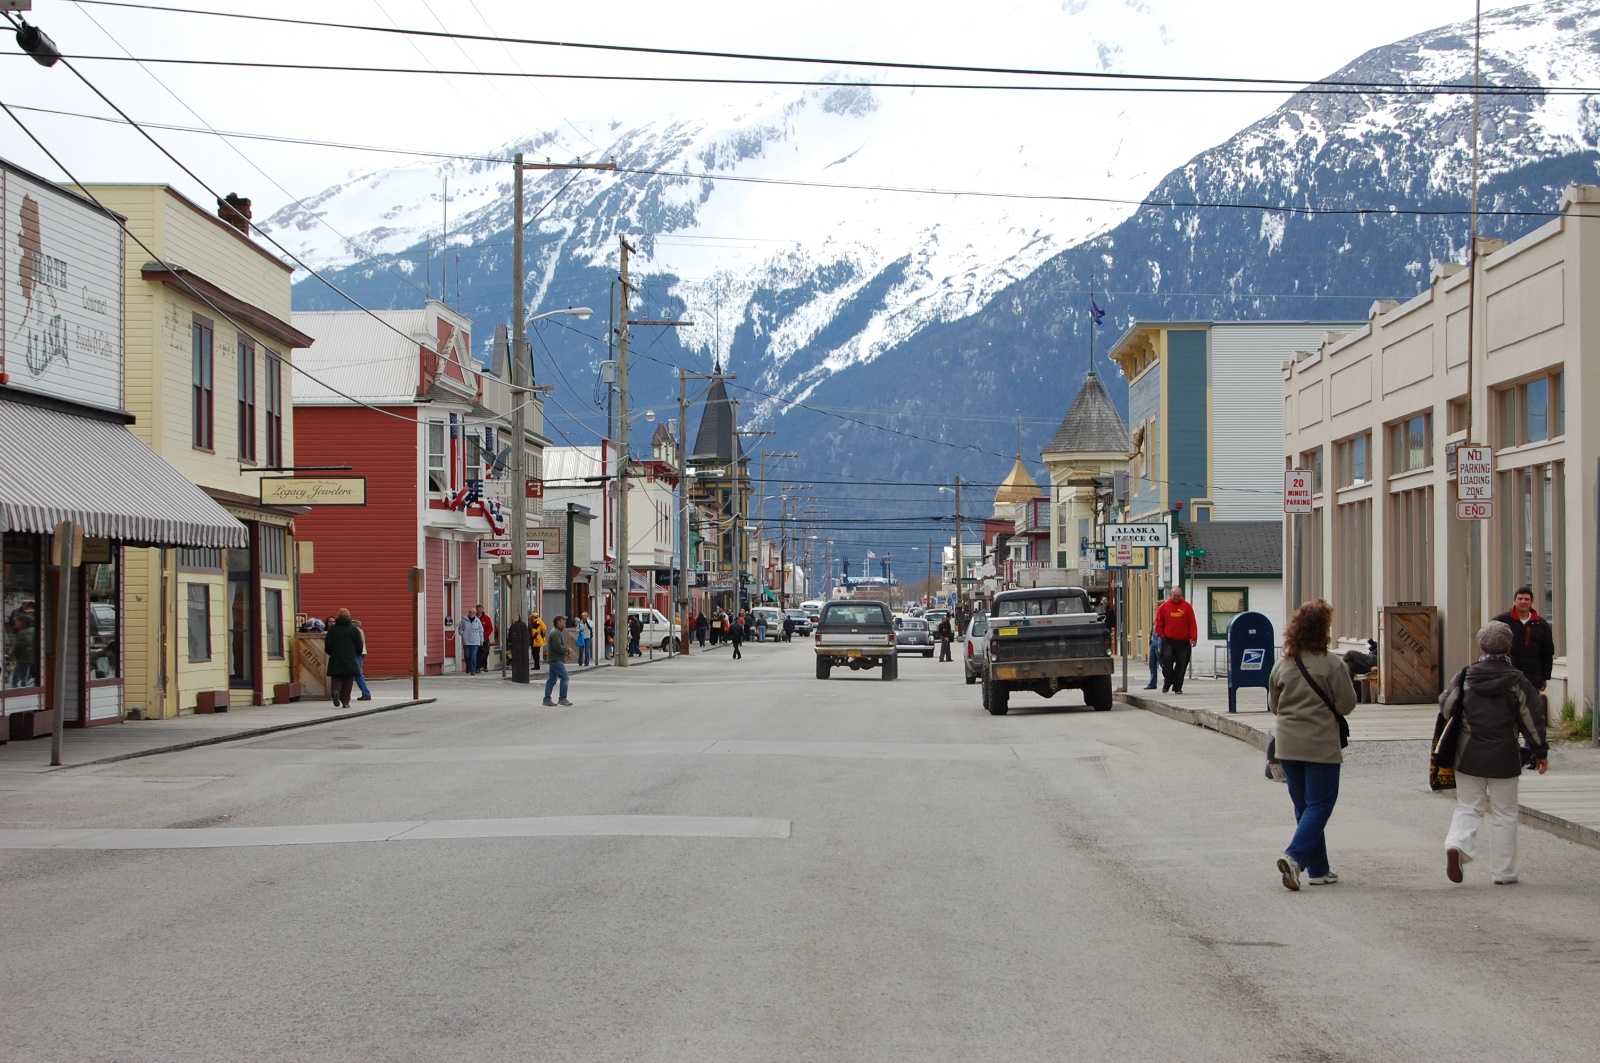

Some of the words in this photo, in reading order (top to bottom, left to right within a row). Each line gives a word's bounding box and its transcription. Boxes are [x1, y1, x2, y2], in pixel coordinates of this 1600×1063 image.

[32, 251, 68, 289] NORTH
[1467, 451, 1482, 461] NO
[1460, 463, 1490, 474] PARKING
[1293, 479, 1304, 488] 20
[1460, 476, 1490, 485] LOADING
[271, 485, 307, 499] Legacy
[306, 484, 353, 499] Jewelers
[1466, 487, 1484, 496] ZONE
[1465, 505, 1486, 515] END
[1396, 628, 1424, 655] LITTER
[302, 648, 322, 668] LITTER
